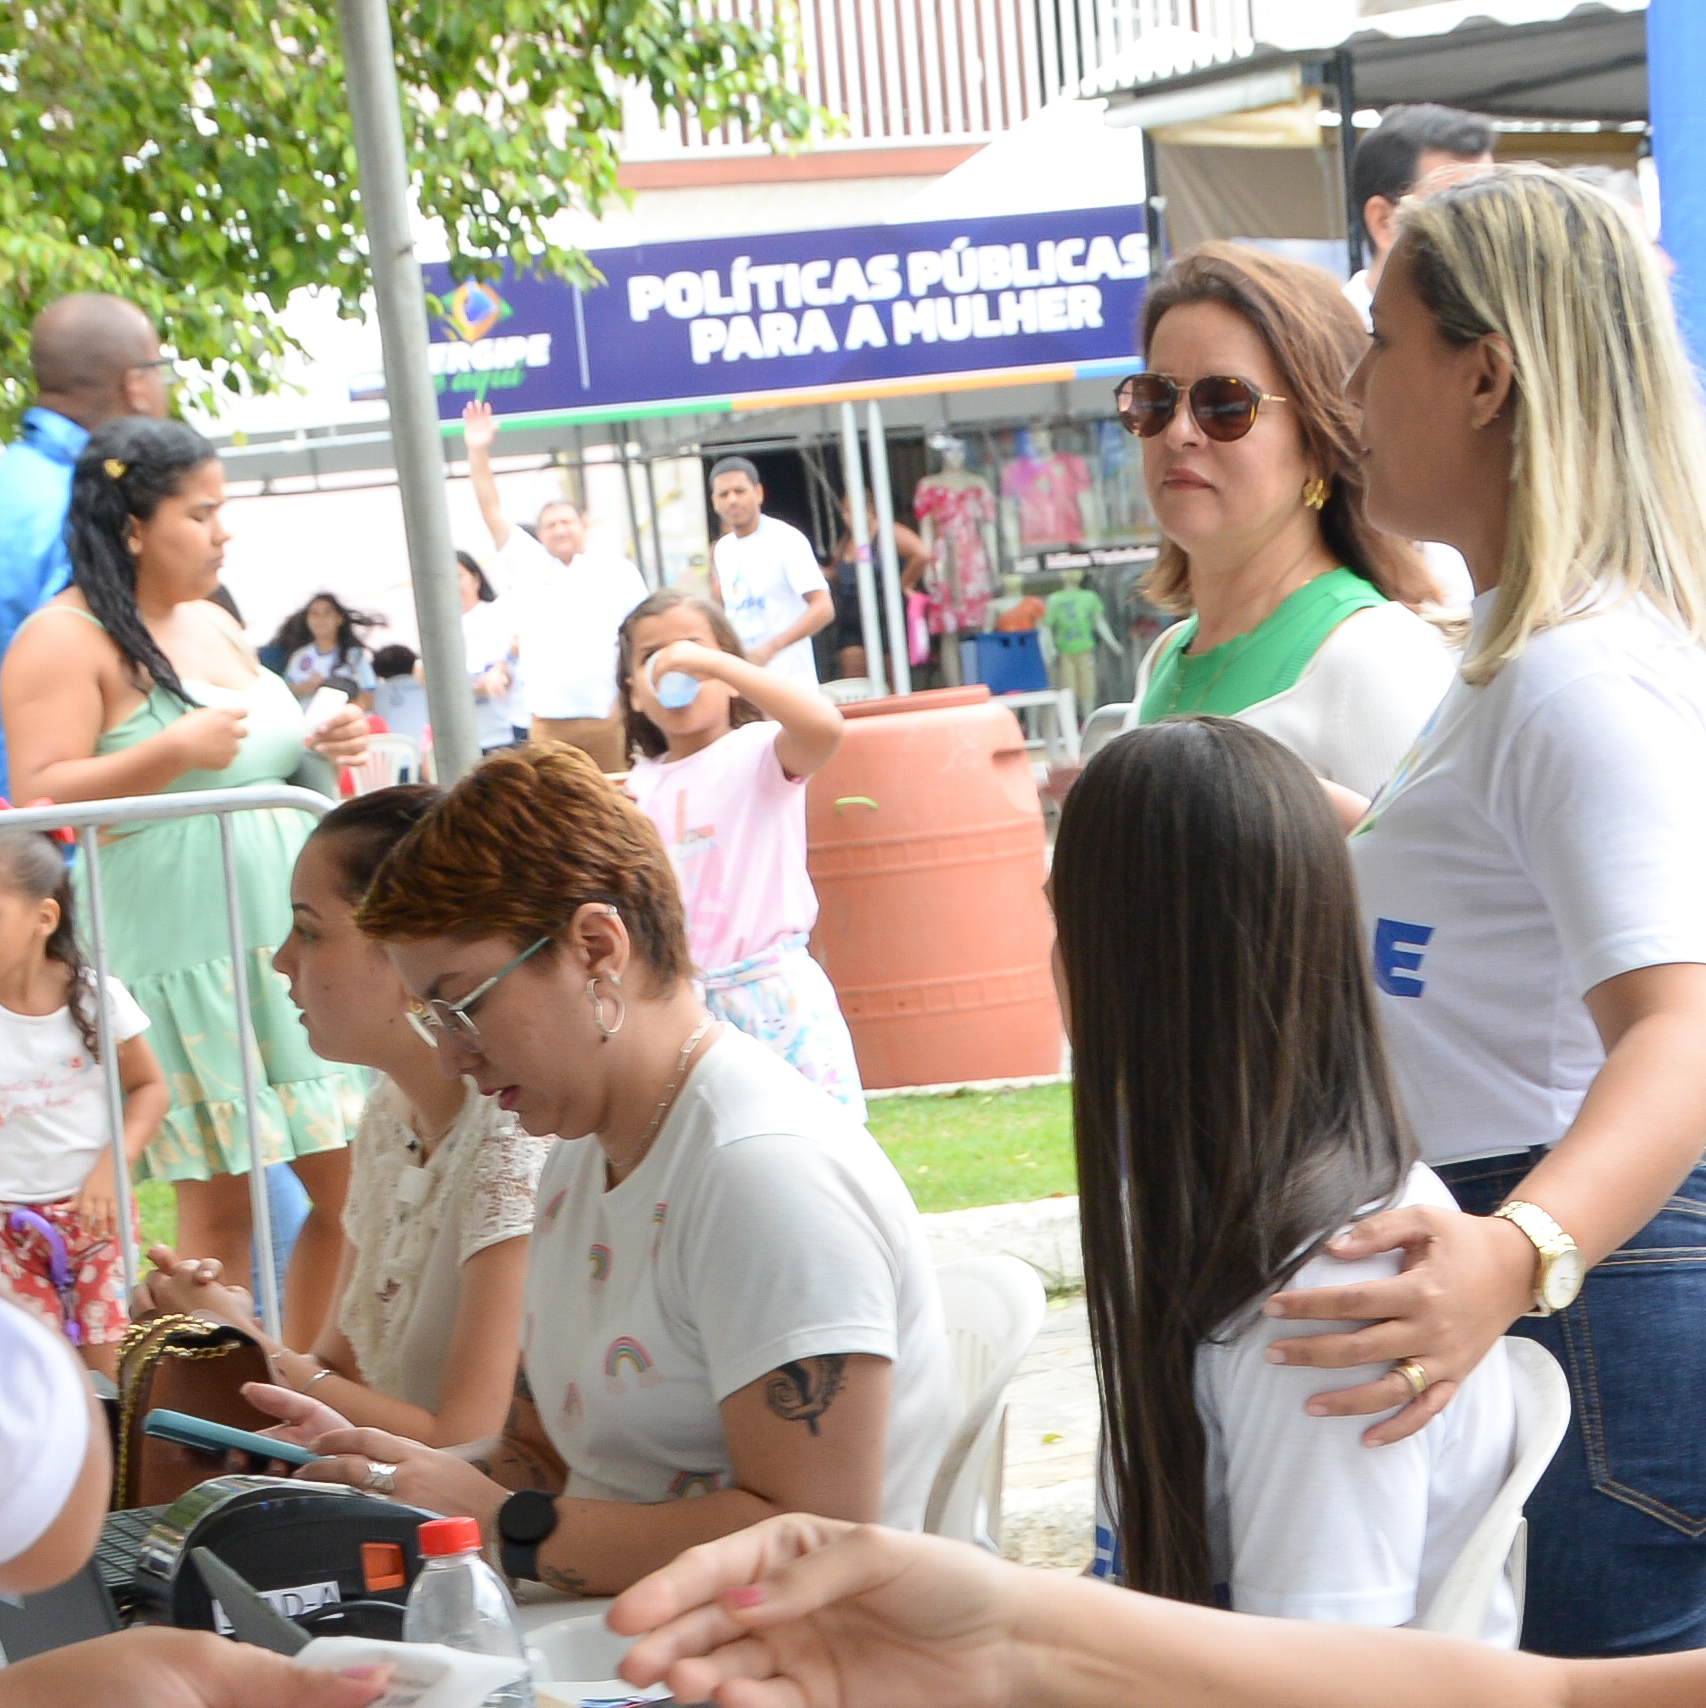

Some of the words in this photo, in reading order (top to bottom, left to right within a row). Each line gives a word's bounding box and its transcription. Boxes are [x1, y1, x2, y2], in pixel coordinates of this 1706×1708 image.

[628, 253, 903, 322] POLÍTICAS
[907, 233, 1152, 298] PÚBLICAS
[689, 308, 839, 364] PARA
[844, 303, 889, 351] A
[892, 285, 1104, 345] MULHER
